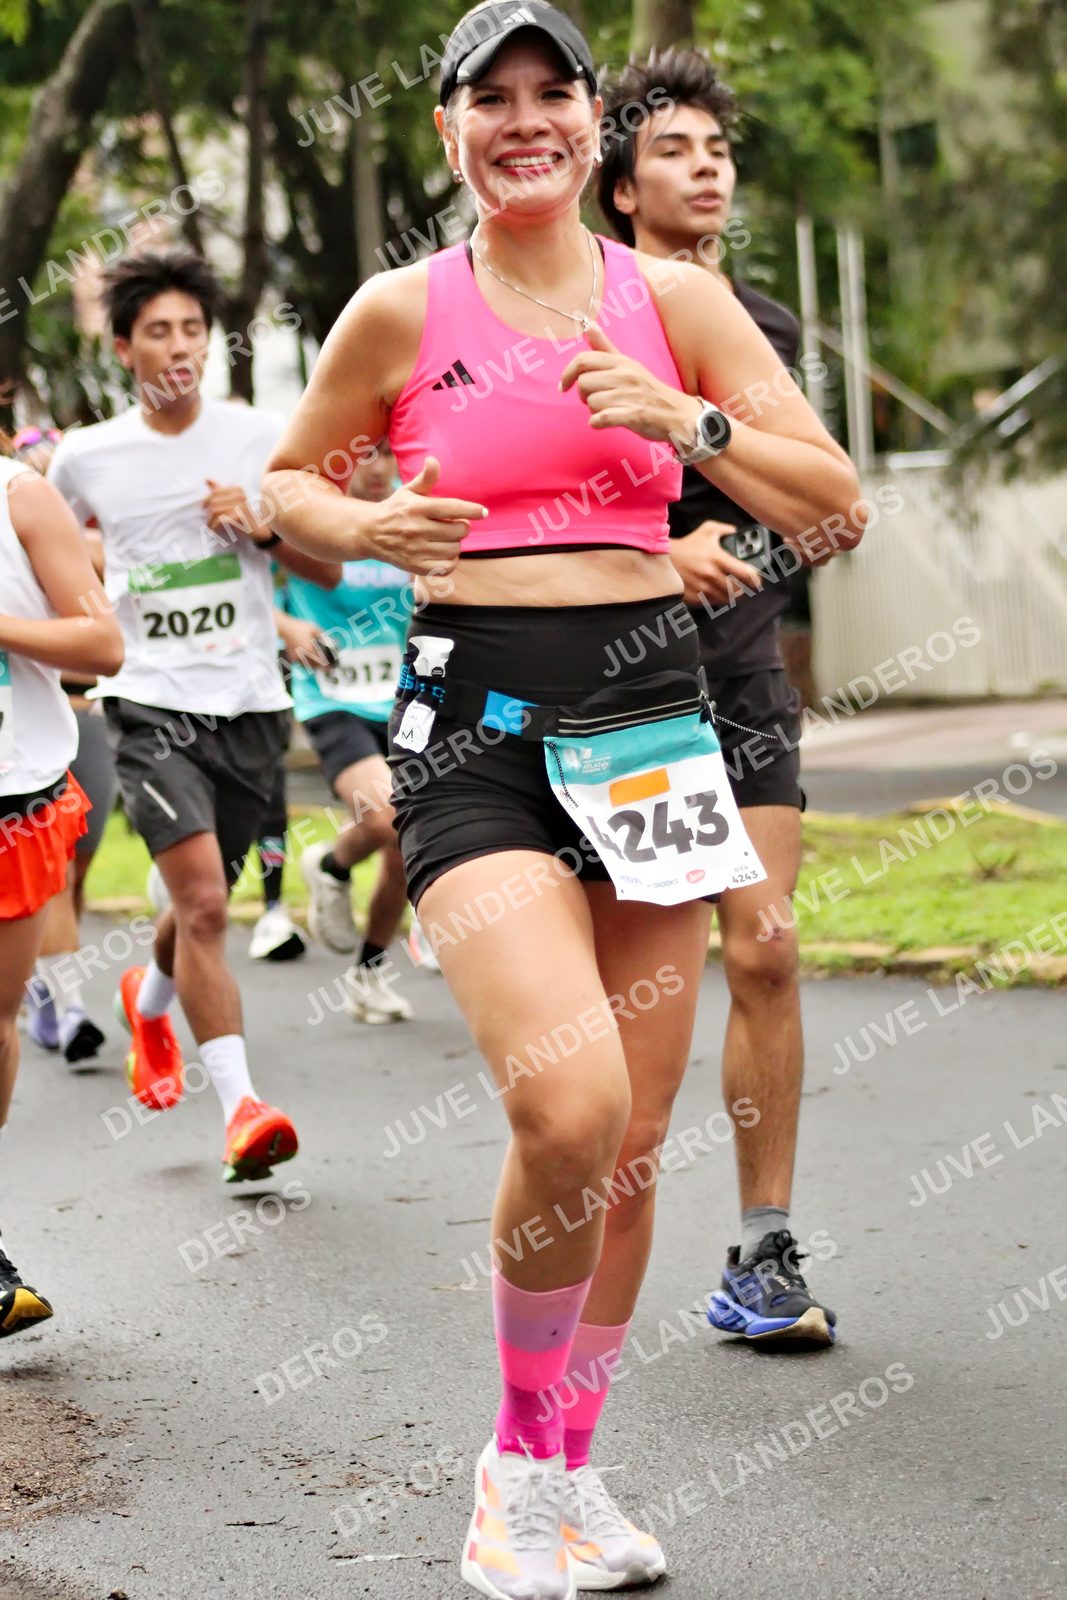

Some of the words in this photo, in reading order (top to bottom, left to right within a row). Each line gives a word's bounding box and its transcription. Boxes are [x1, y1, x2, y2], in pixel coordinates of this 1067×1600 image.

[143, 602, 235, 638] 2020
[586, 790, 729, 863] 4243
[732, 870, 758, 884] 4243
